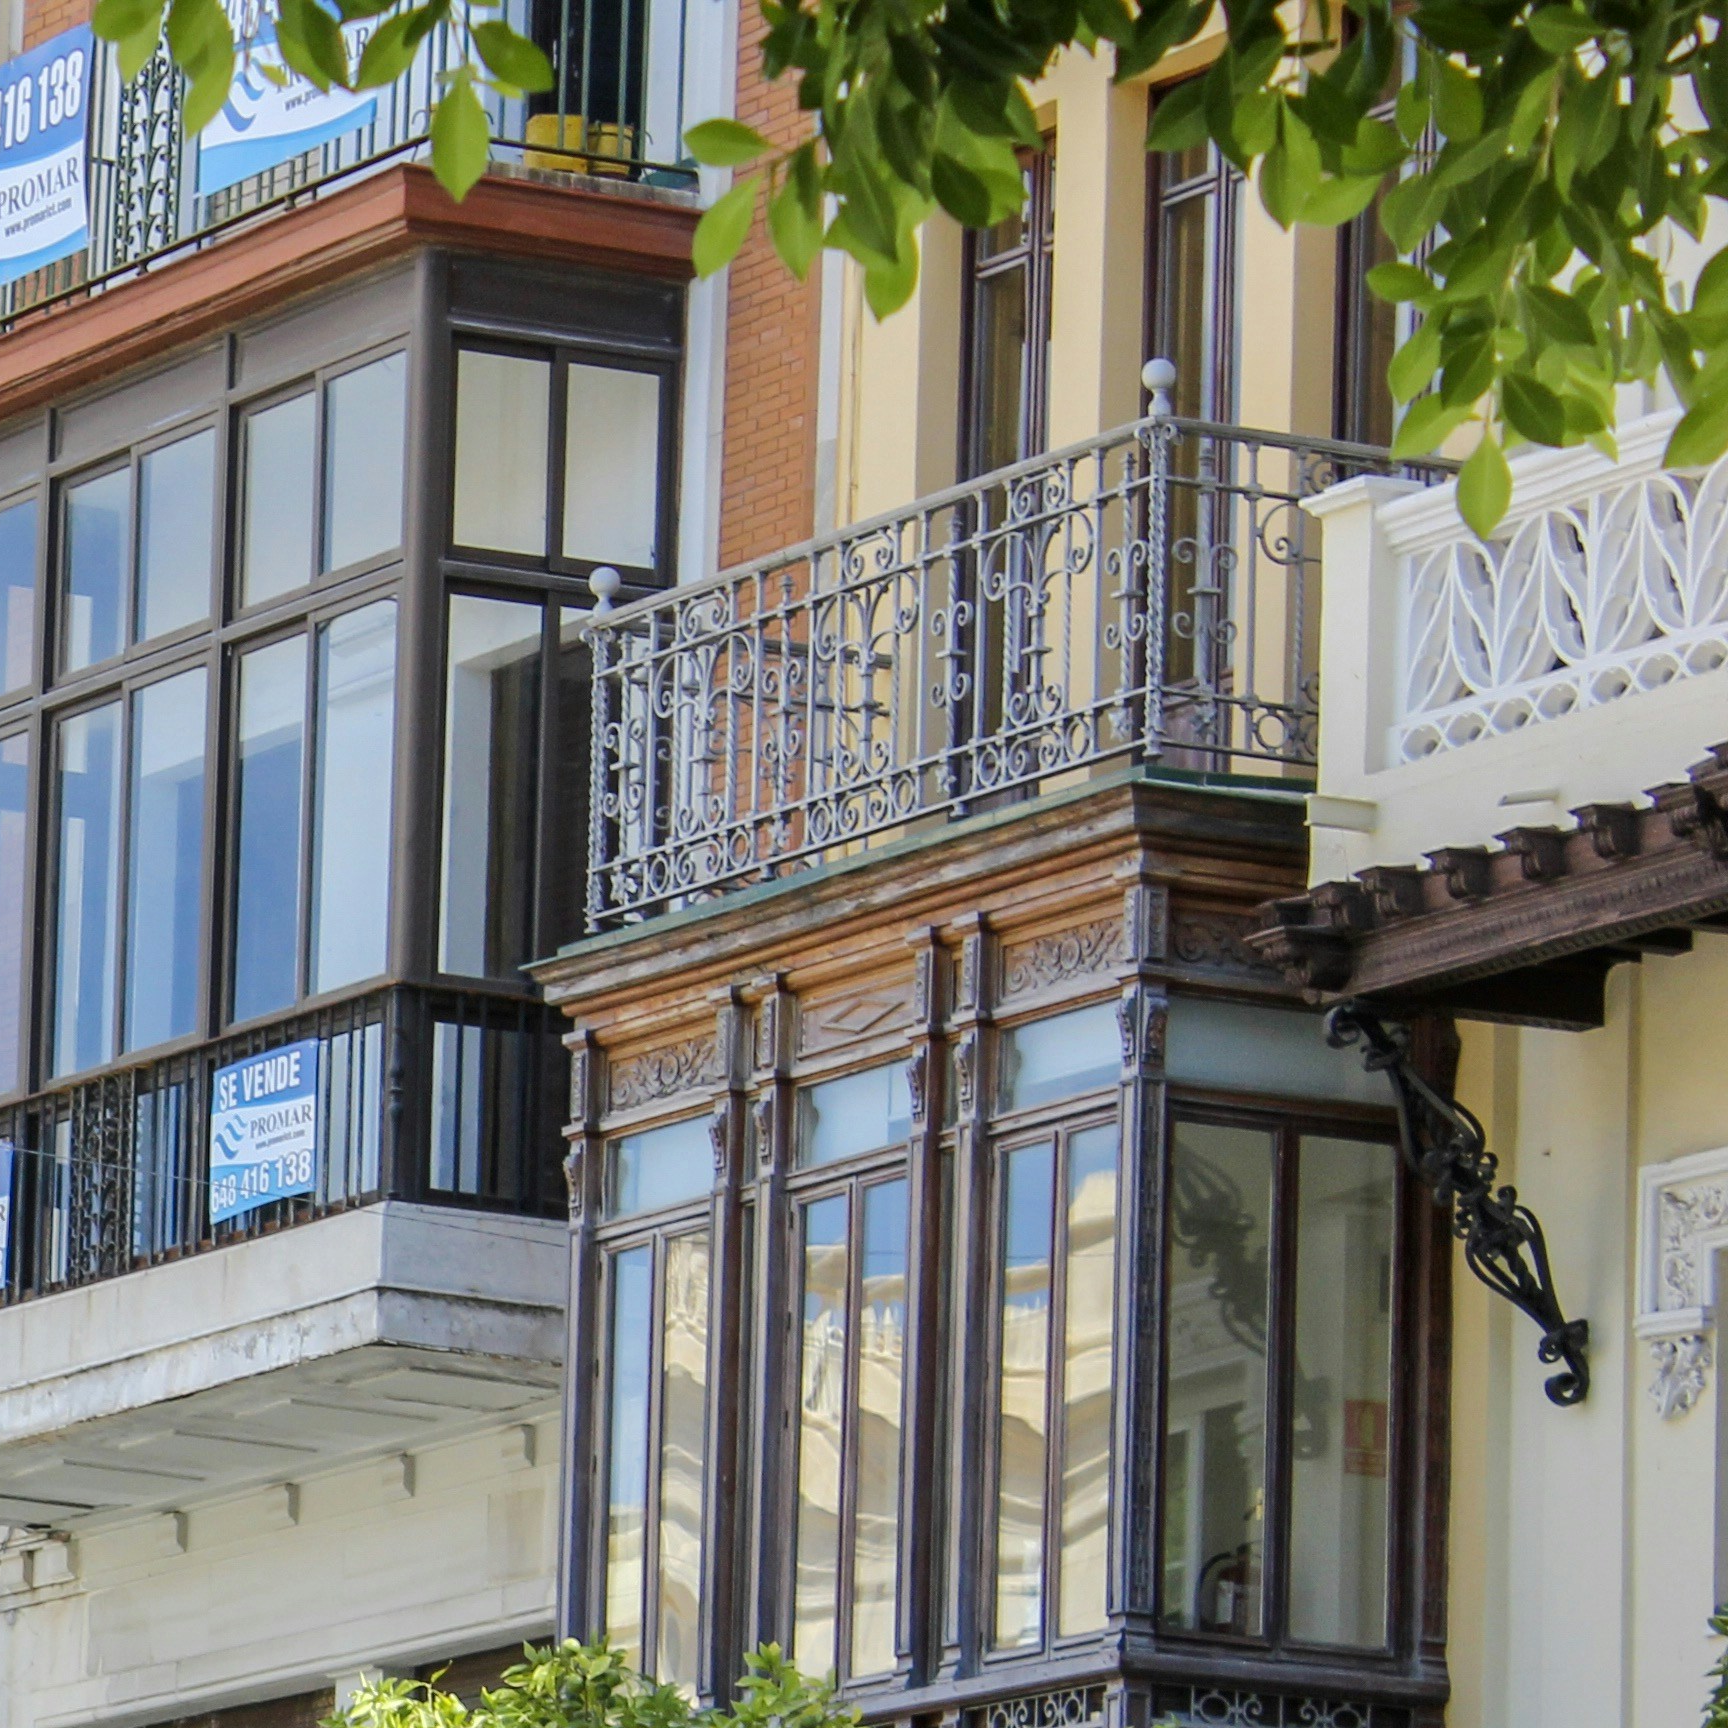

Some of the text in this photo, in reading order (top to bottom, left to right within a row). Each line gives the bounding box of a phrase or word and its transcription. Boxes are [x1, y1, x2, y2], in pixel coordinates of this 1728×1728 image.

[38, 49, 83, 132] 138
[219, 1051, 301, 1112] SE VENDE
[250, 1103, 312, 1139] PROMAR
[211, 1150, 312, 1213] 648 416 138
